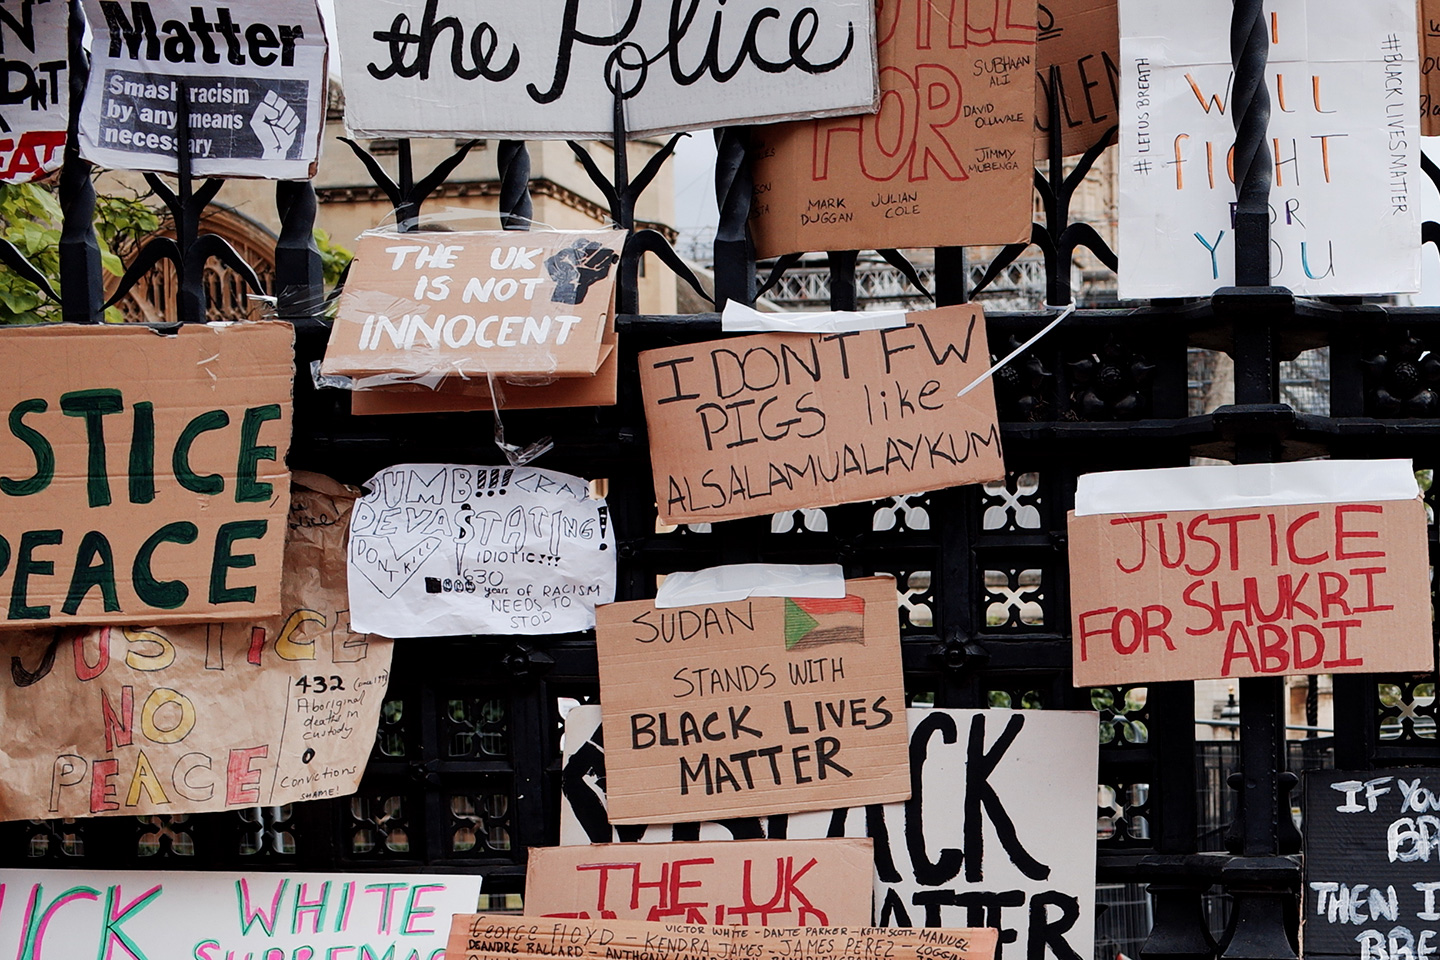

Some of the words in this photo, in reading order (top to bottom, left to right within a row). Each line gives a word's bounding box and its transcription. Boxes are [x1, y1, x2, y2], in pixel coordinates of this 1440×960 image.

[107, 0, 305, 67] Matter
[109, 75, 179, 101] Smash
[190, 85, 249, 104] racism
[990, 74, 1011, 88] ALI
[107, 97, 133, 123] by
[140, 104, 179, 129] any
[188, 110, 243, 130] means
[963, 103, 994, 117] DAVID
[975, 147, 1016, 162] JIMMY
[808, 198, 846, 212] MARK
[871, 192, 918, 207] JULIAN
[885, 205, 920, 219] COLE
[801, 212, 853, 226] DUGGAN
[385, 245, 458, 271] THE
[491, 247, 544, 270] UK
[415, 275, 454, 301] IS
[462, 277, 545, 303] NOT
[359, 314, 581, 351] INNOCENT
[654, 356, 701, 405] I
[712, 330, 860, 400] DON'T
[881, 314, 976, 375] FW
[696, 391, 826, 450] PIGS
[864, 379, 944, 426] like
[1110, 504, 1387, 577] JUSTICE
[634, 603, 755, 644] SUDAN
[1079, 604, 1178, 661] FOR
[1183, 566, 1395, 637] SHUKRI
[1221, 619, 1363, 676] ABDI
[295, 675, 345, 694] 432
[674, 663, 777, 699] STANDS
[788, 657, 845, 687] WITH
[297, 690, 366, 715] Aboriginal
[630, 704, 763, 750] BLACK
[785, 694, 894, 735] LIVES
[681, 736, 853, 796] MATTER
[1329, 775, 1394, 815] IF
[1310, 881, 1399, 926] THEN
